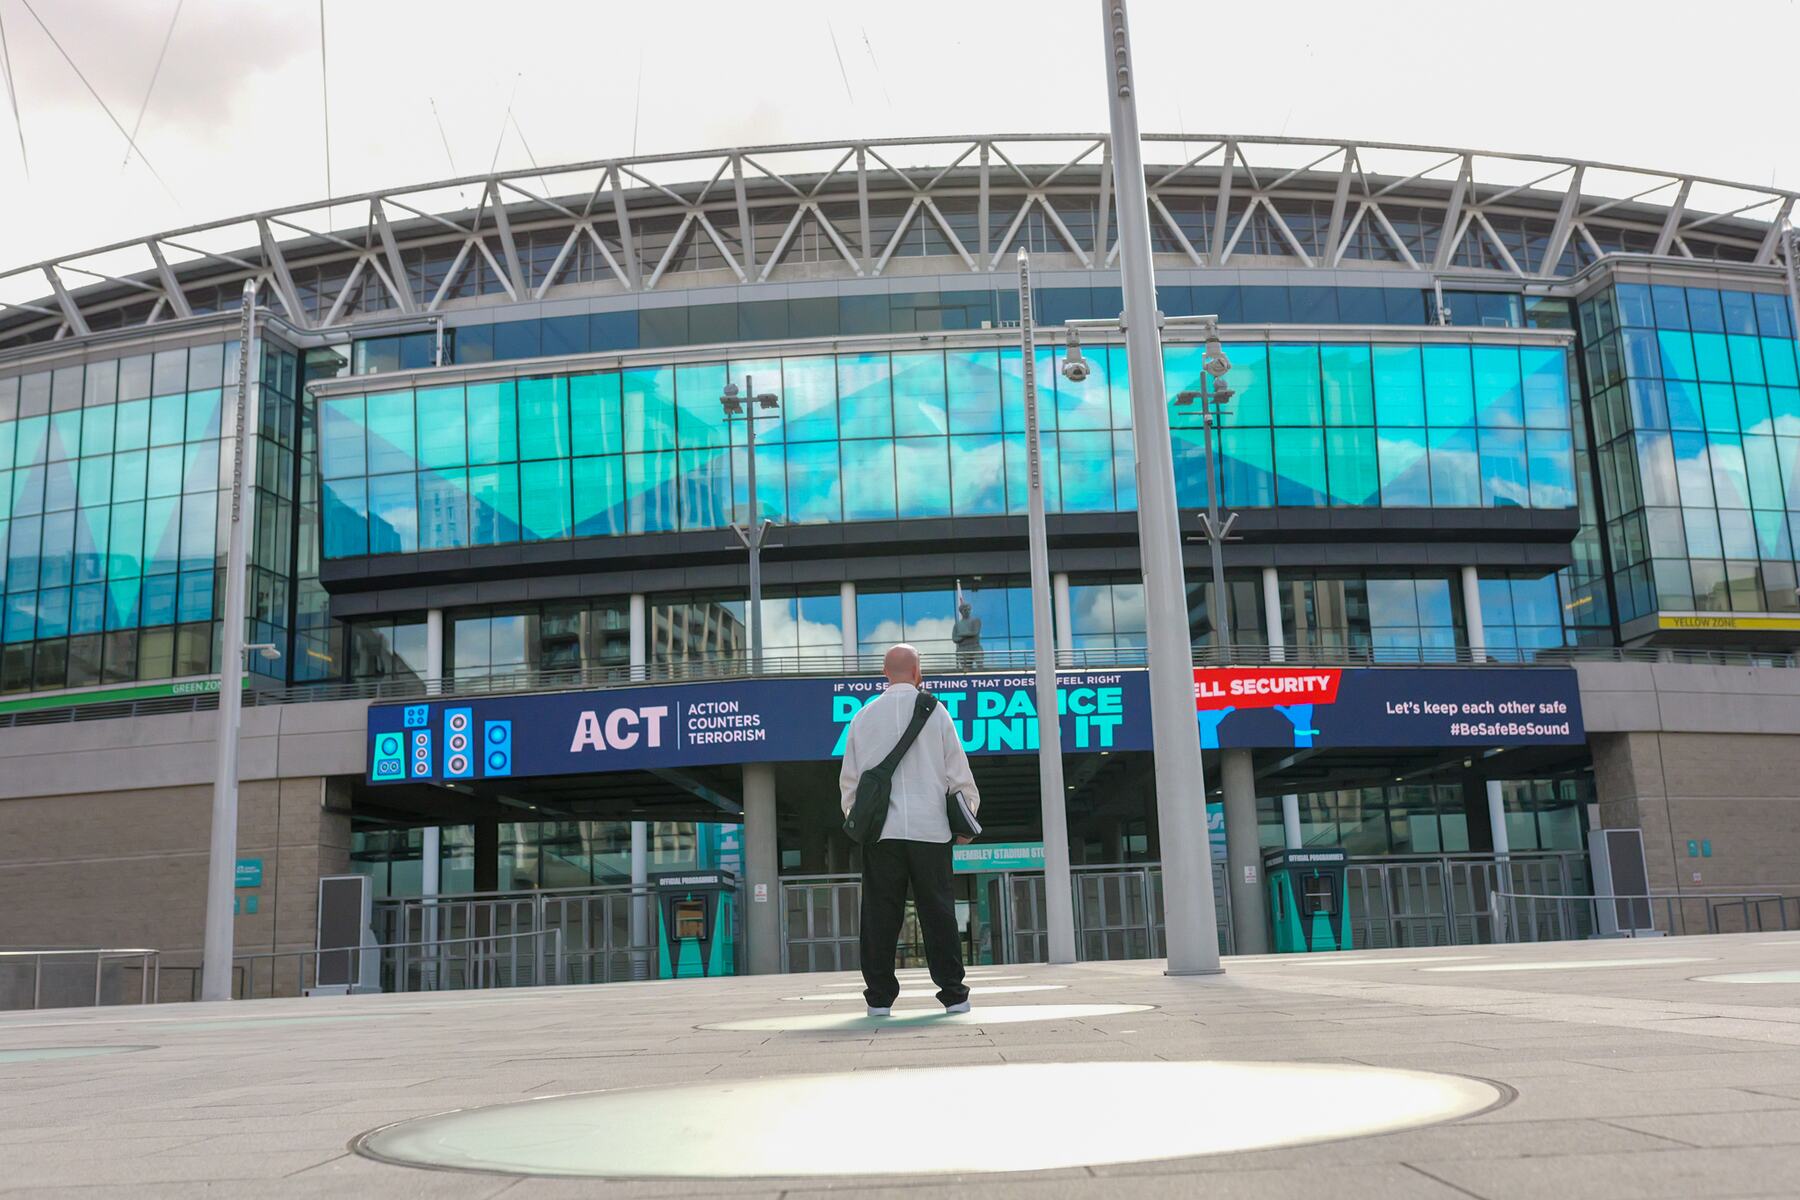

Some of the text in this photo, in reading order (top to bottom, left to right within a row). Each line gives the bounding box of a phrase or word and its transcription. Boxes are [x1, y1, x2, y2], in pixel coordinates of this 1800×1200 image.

[1673, 617, 1737, 628] YELLOW ZONE
[172, 681, 222, 694] GREEN ZO
[834, 675, 1121, 692] IF YOU SE METHING THAT DOES FEEL RIGHT
[1230, 675, 1331, 695] SECURITY
[688, 701, 739, 715] ACTION
[1386, 701, 1567, 716] Let's keep each other safe
[570, 706, 668, 752] ACT
[688, 714, 760, 730] COUNTERS
[1450, 722, 1570, 736] #BeSafeBeSound
[688, 729, 766, 745] TERRORISM
[1075, 715, 1123, 748] IT
[954, 849, 992, 860] WEMBLEY
[1031, 847, 1045, 858] STO
